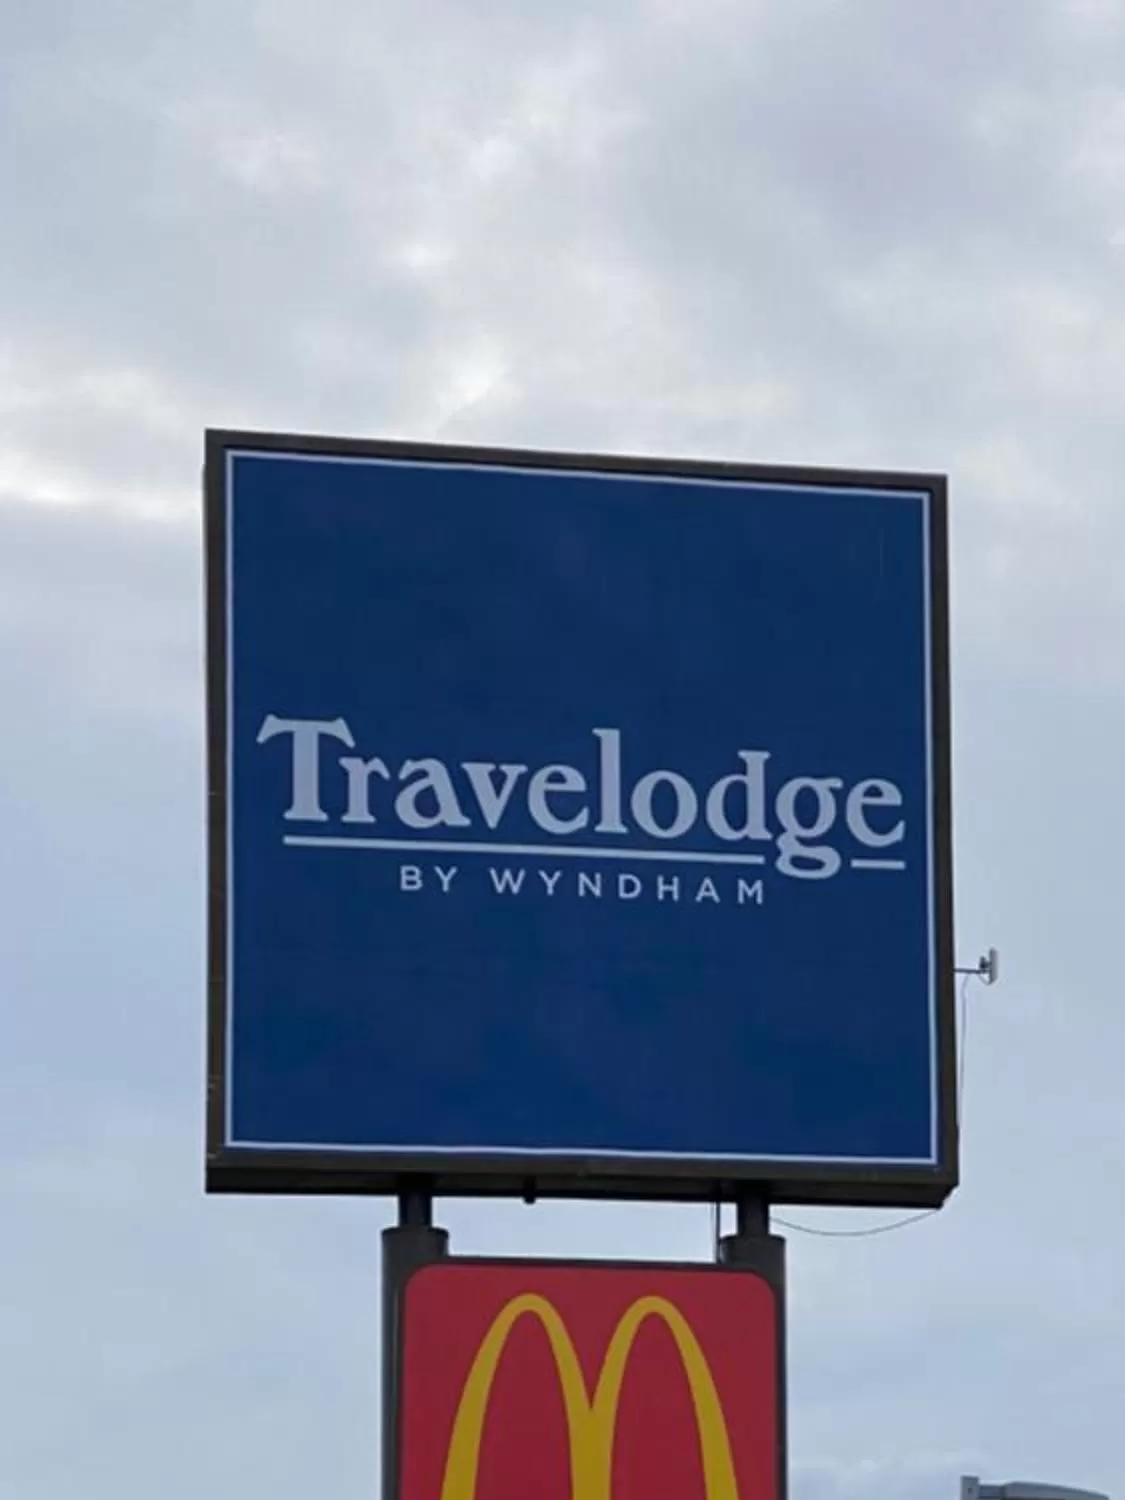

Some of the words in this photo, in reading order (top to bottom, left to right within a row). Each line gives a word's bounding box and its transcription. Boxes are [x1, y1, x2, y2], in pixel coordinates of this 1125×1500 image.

[256, 714, 905, 879] Travelodge
[401, 865, 457, 892] BY
[490, 868, 764, 904] WYNDHAM
